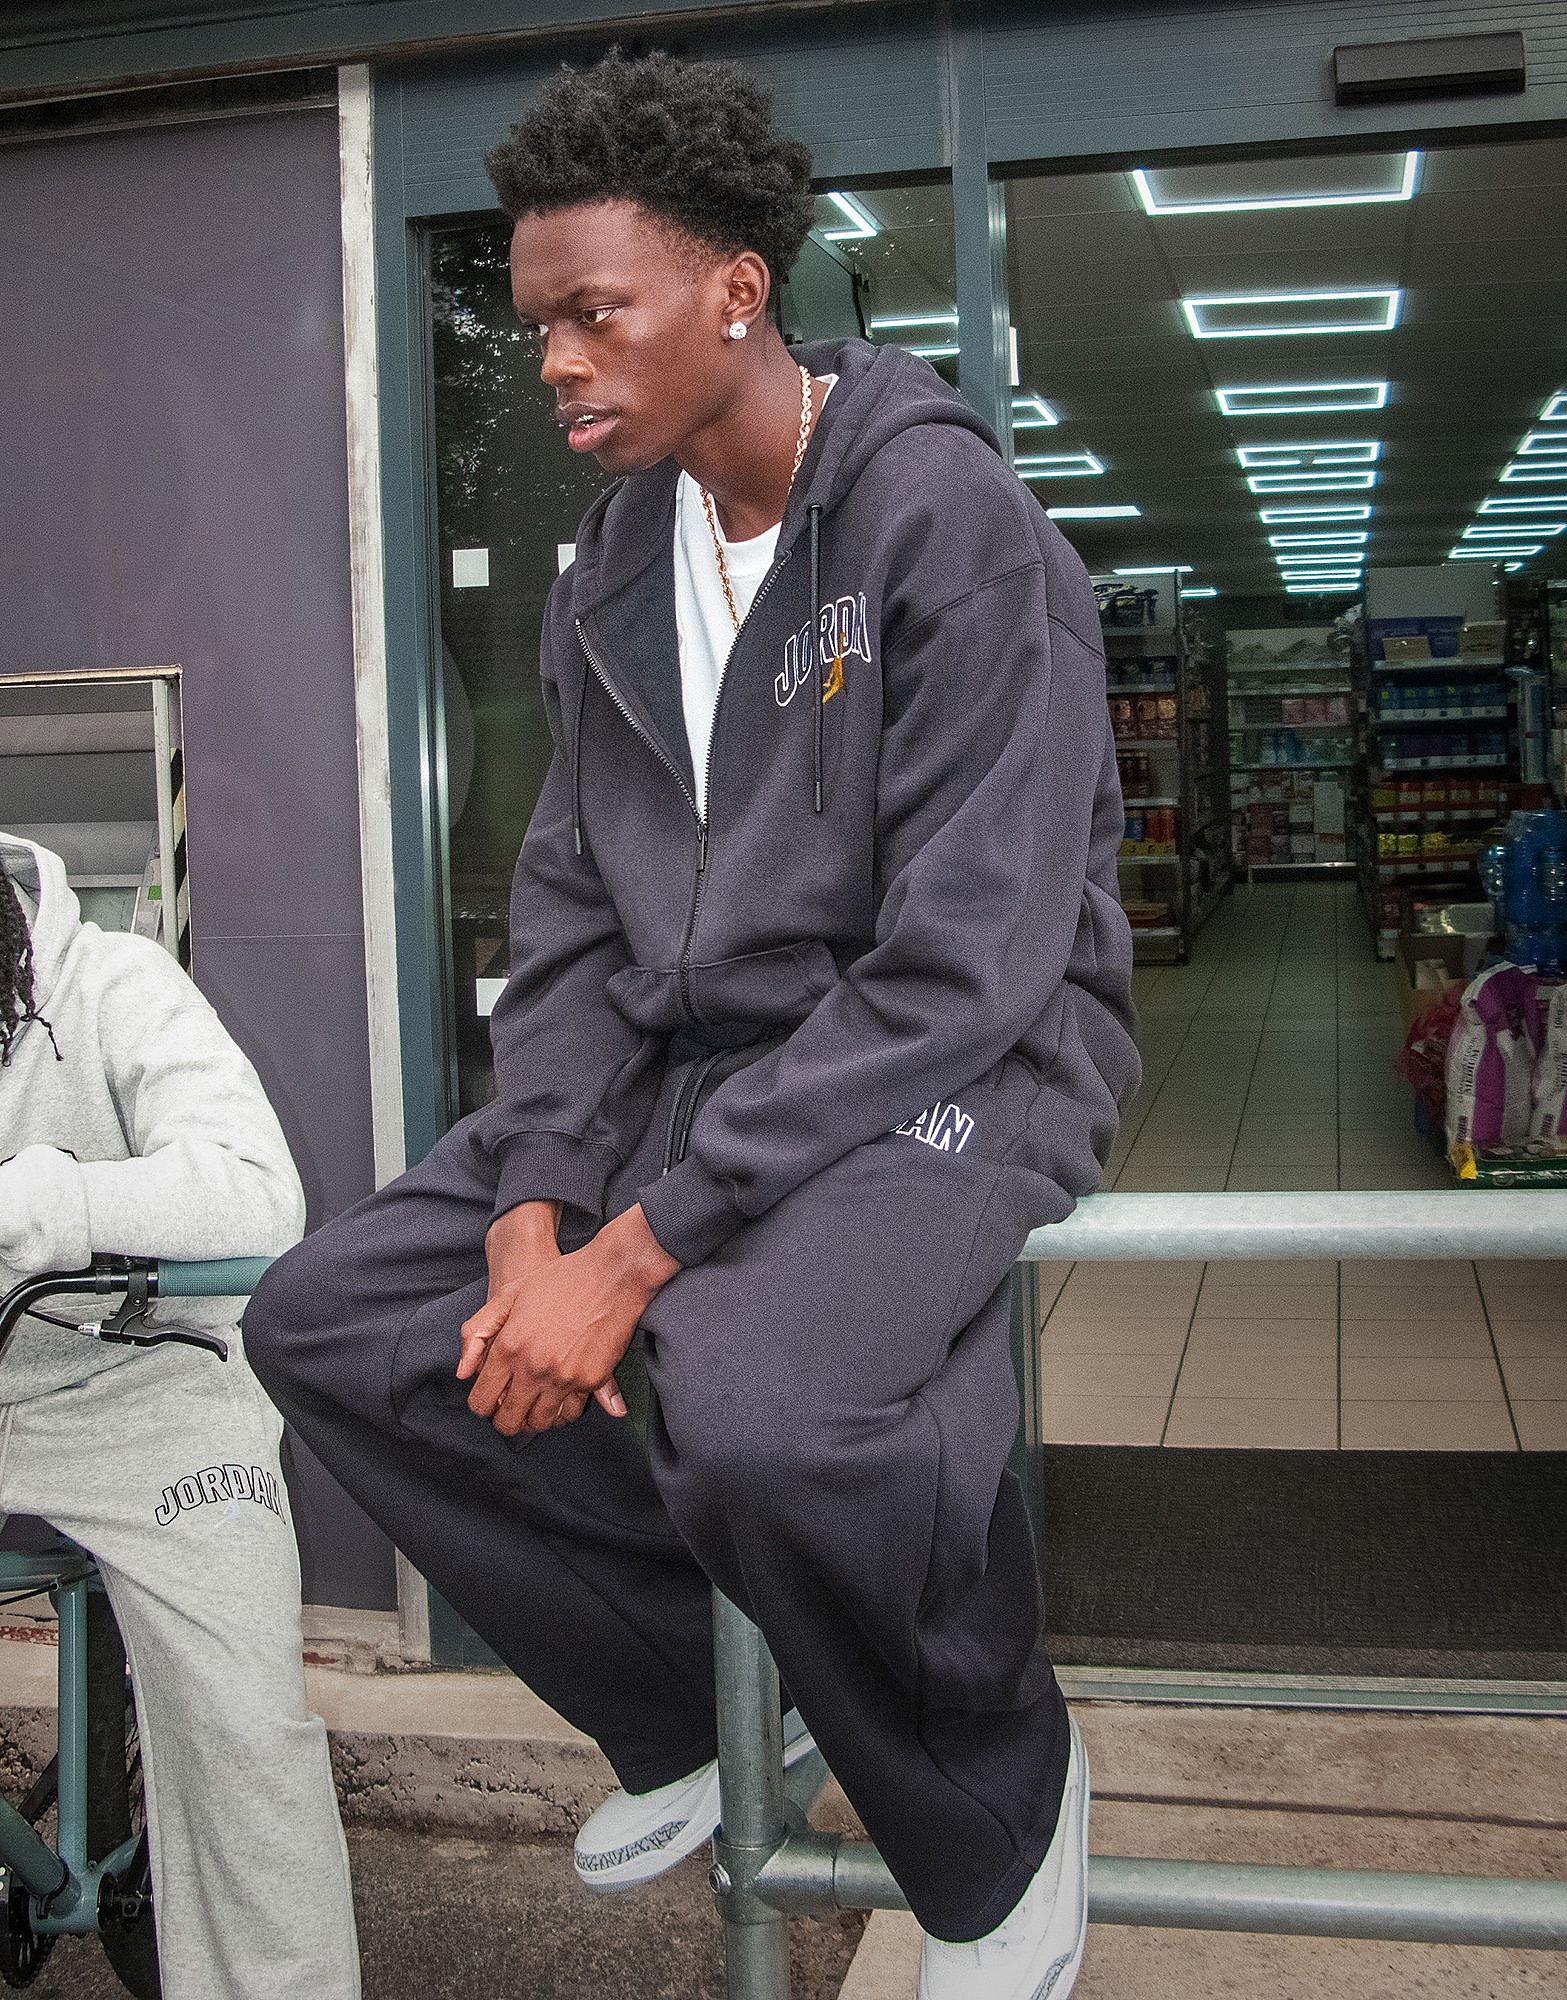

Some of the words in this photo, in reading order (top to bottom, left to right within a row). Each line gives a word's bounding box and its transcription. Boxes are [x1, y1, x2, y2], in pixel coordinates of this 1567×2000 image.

[1464, 1049, 1480, 1093] MEDIUM
[889, 1101, 975, 1153] AN
[155, 1463, 286, 1527] JORDAN
